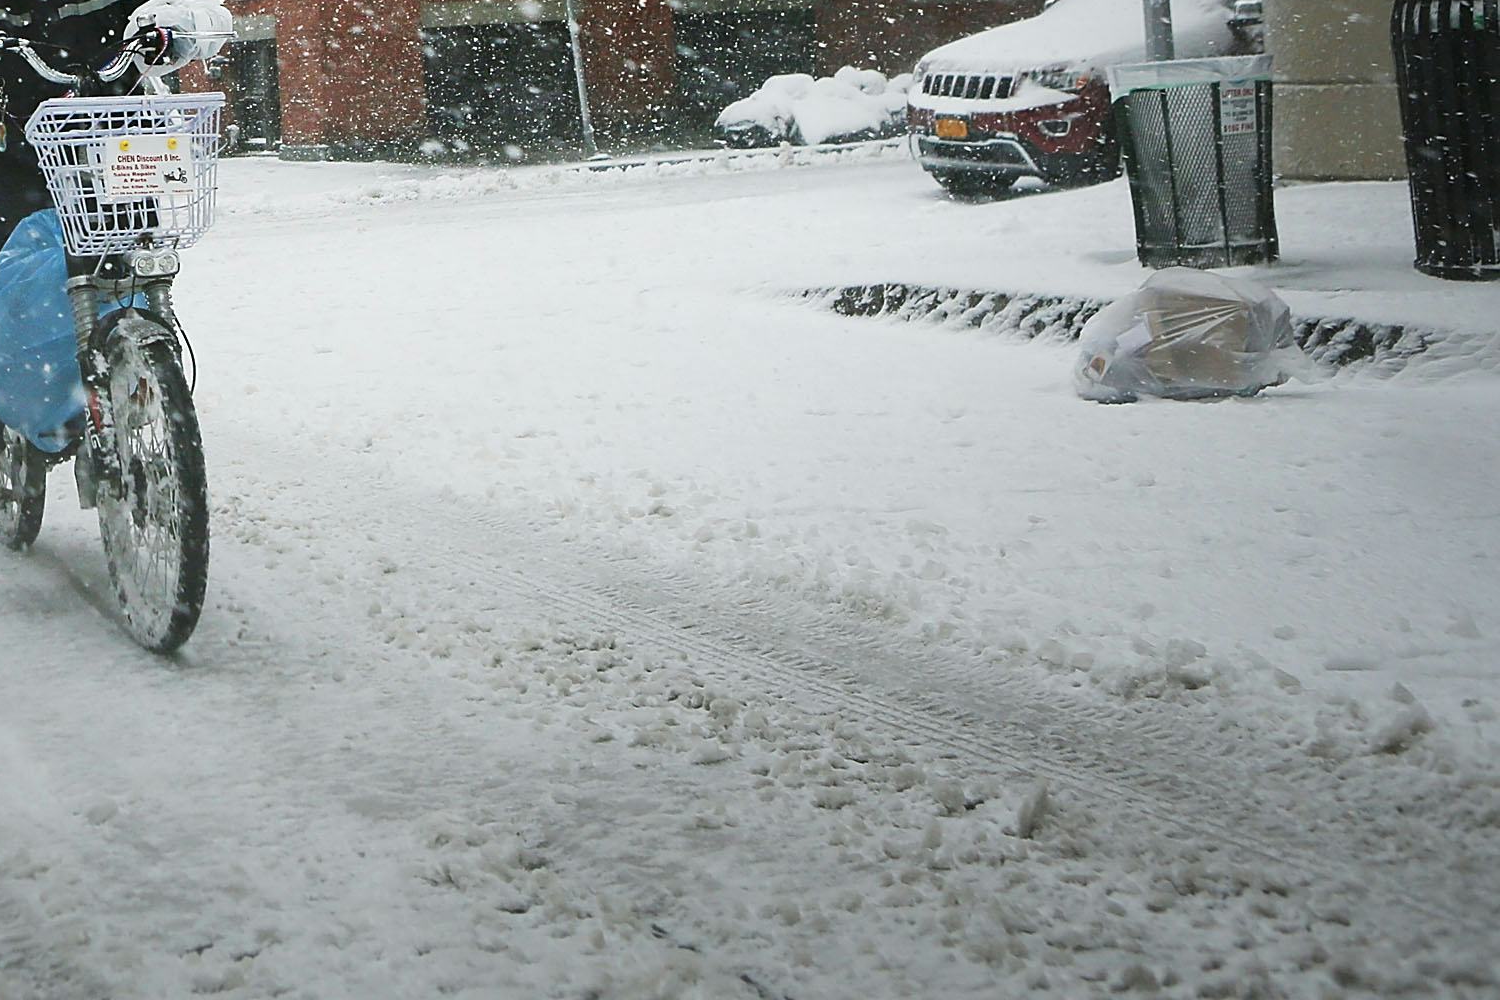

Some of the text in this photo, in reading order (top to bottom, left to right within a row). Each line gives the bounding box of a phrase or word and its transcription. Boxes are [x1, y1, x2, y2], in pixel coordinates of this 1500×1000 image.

[117, 155, 135, 163] CHEN
[136, 154, 163, 163] Discount
[169, 154, 181, 162] Inc.
